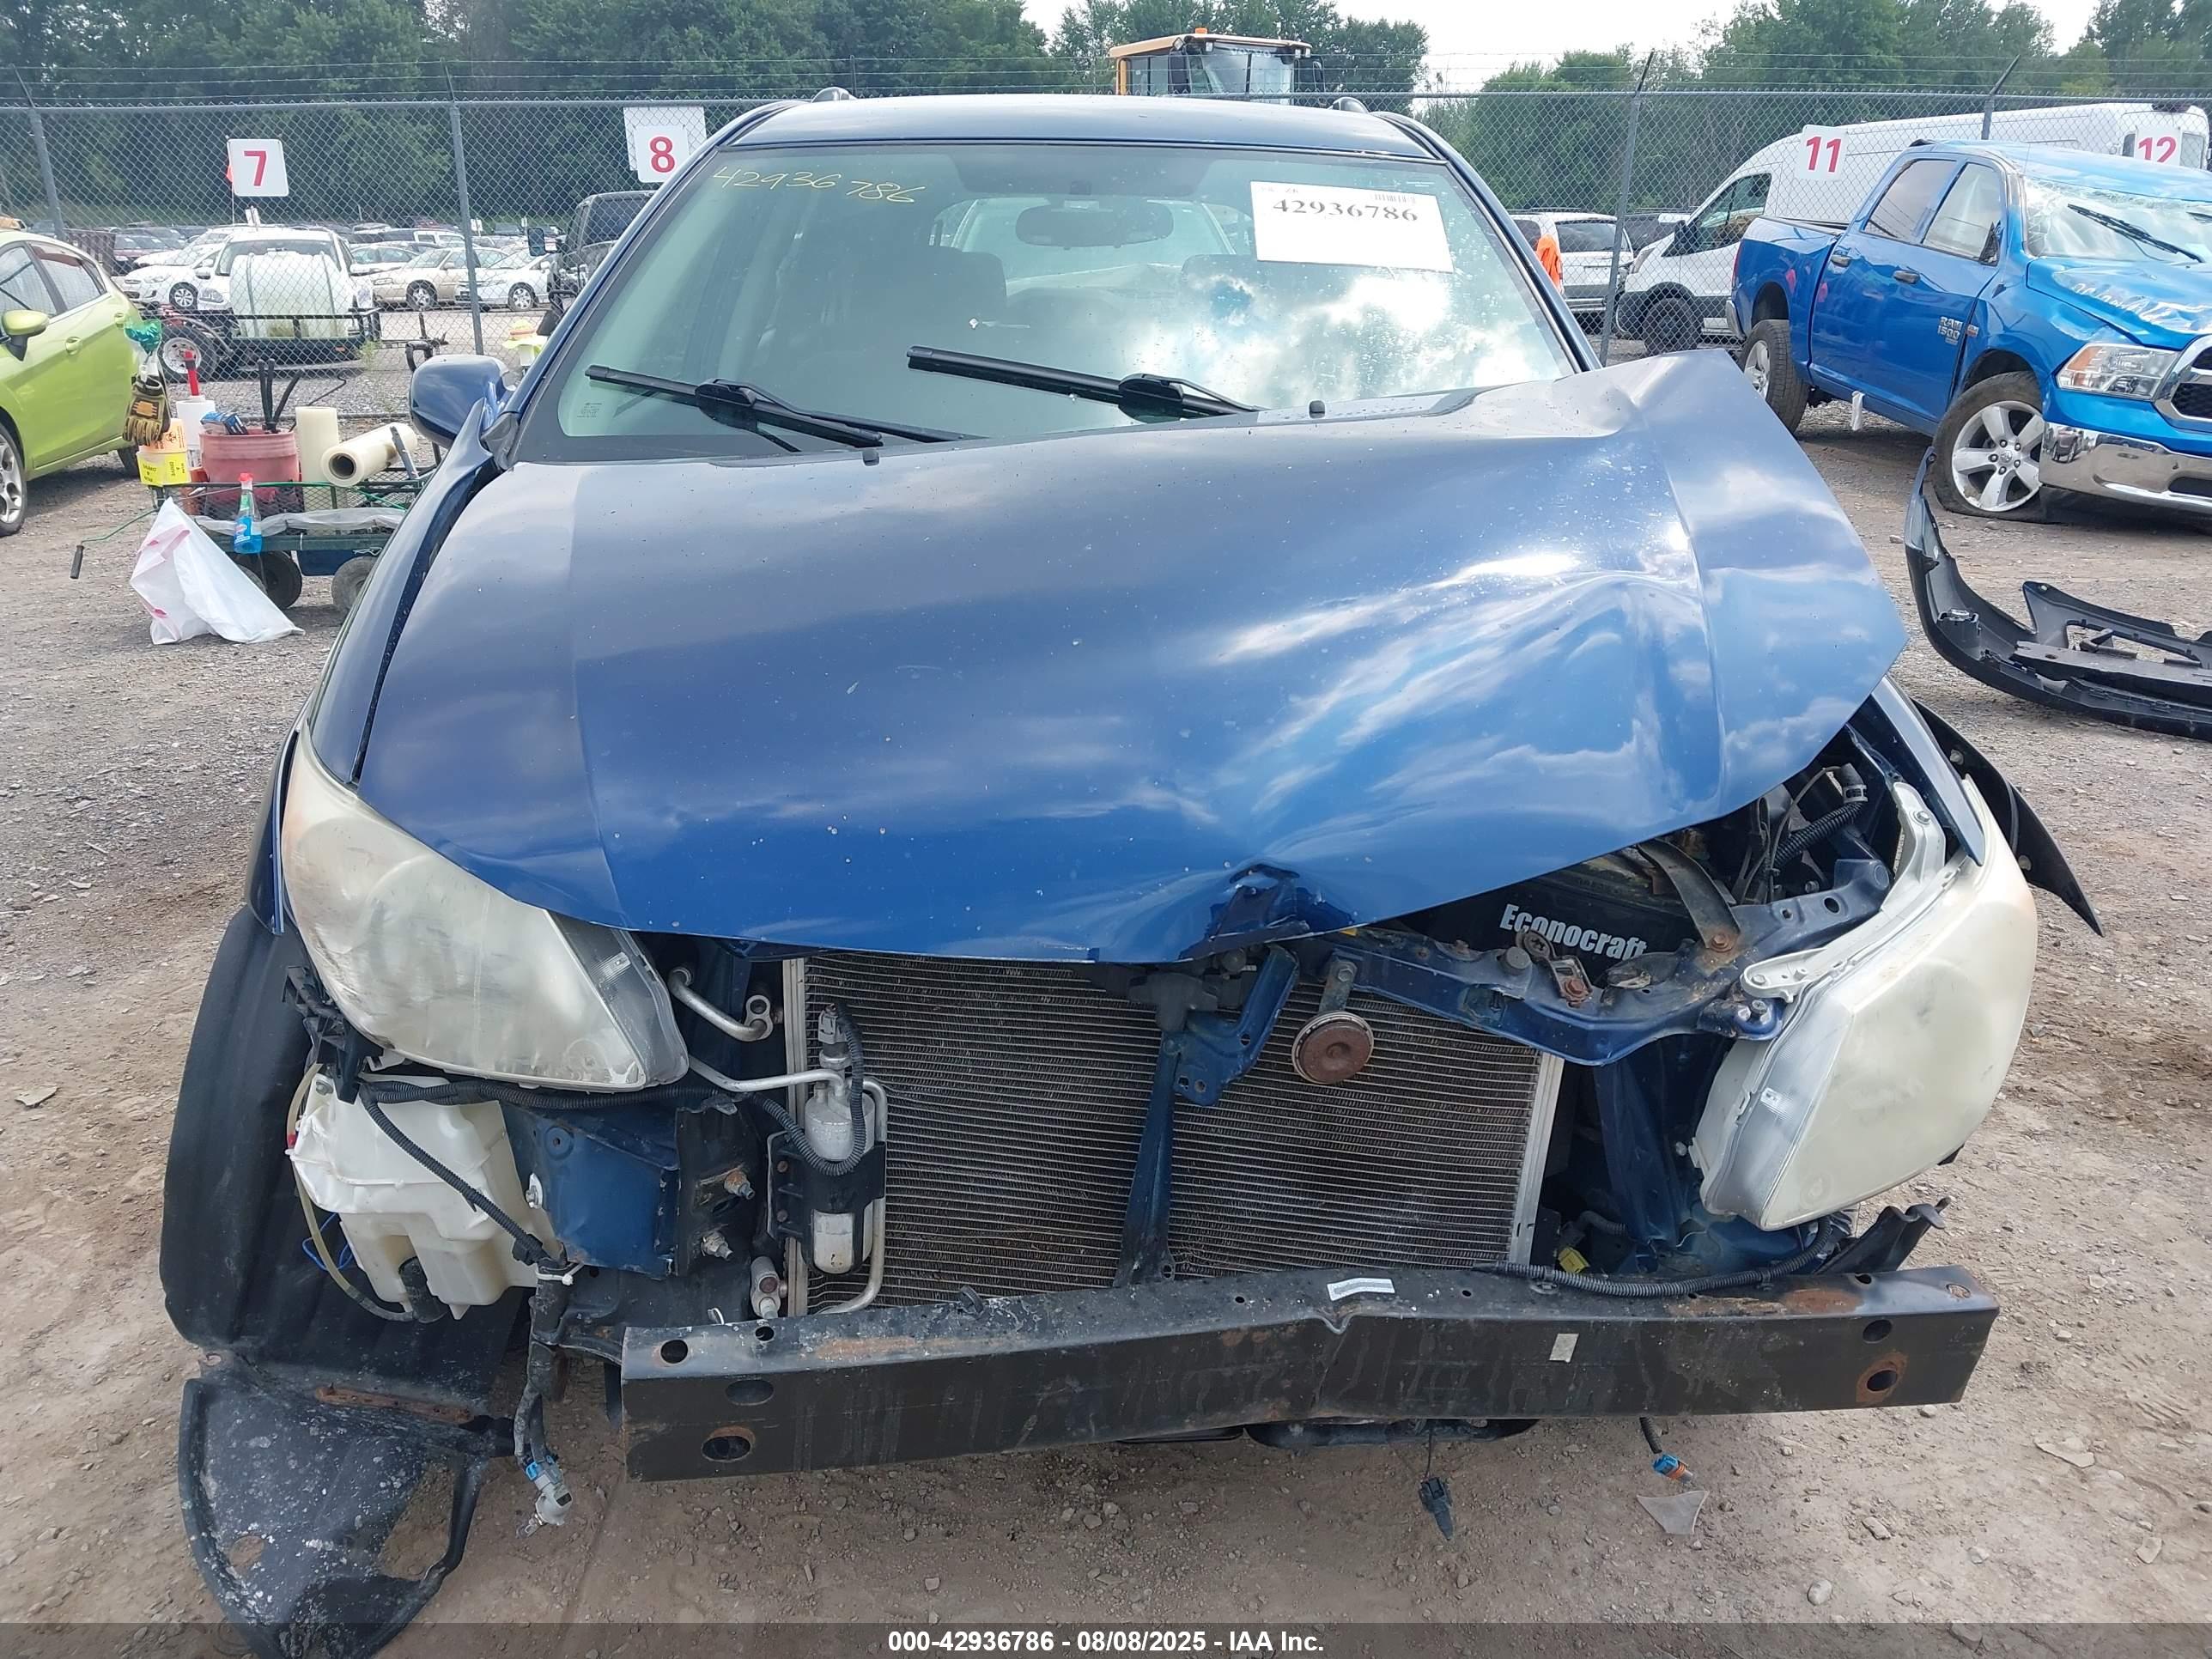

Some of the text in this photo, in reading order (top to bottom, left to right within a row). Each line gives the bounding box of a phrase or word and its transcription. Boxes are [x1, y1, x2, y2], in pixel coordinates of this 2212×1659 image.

[649, 136, 676, 173] 8
[1806, 136, 1842, 173] 11
[2137, 136, 2177, 163] 12
[243, 150, 267, 186] 7
[712, 166, 927, 203] 42936 786
[1273, 198, 1419, 222] 42936786
[1936, 325, 1961, 340] 1500
[1939, 316, 1964, 331] RAM
[1499, 903, 1648, 961] Econocraft
